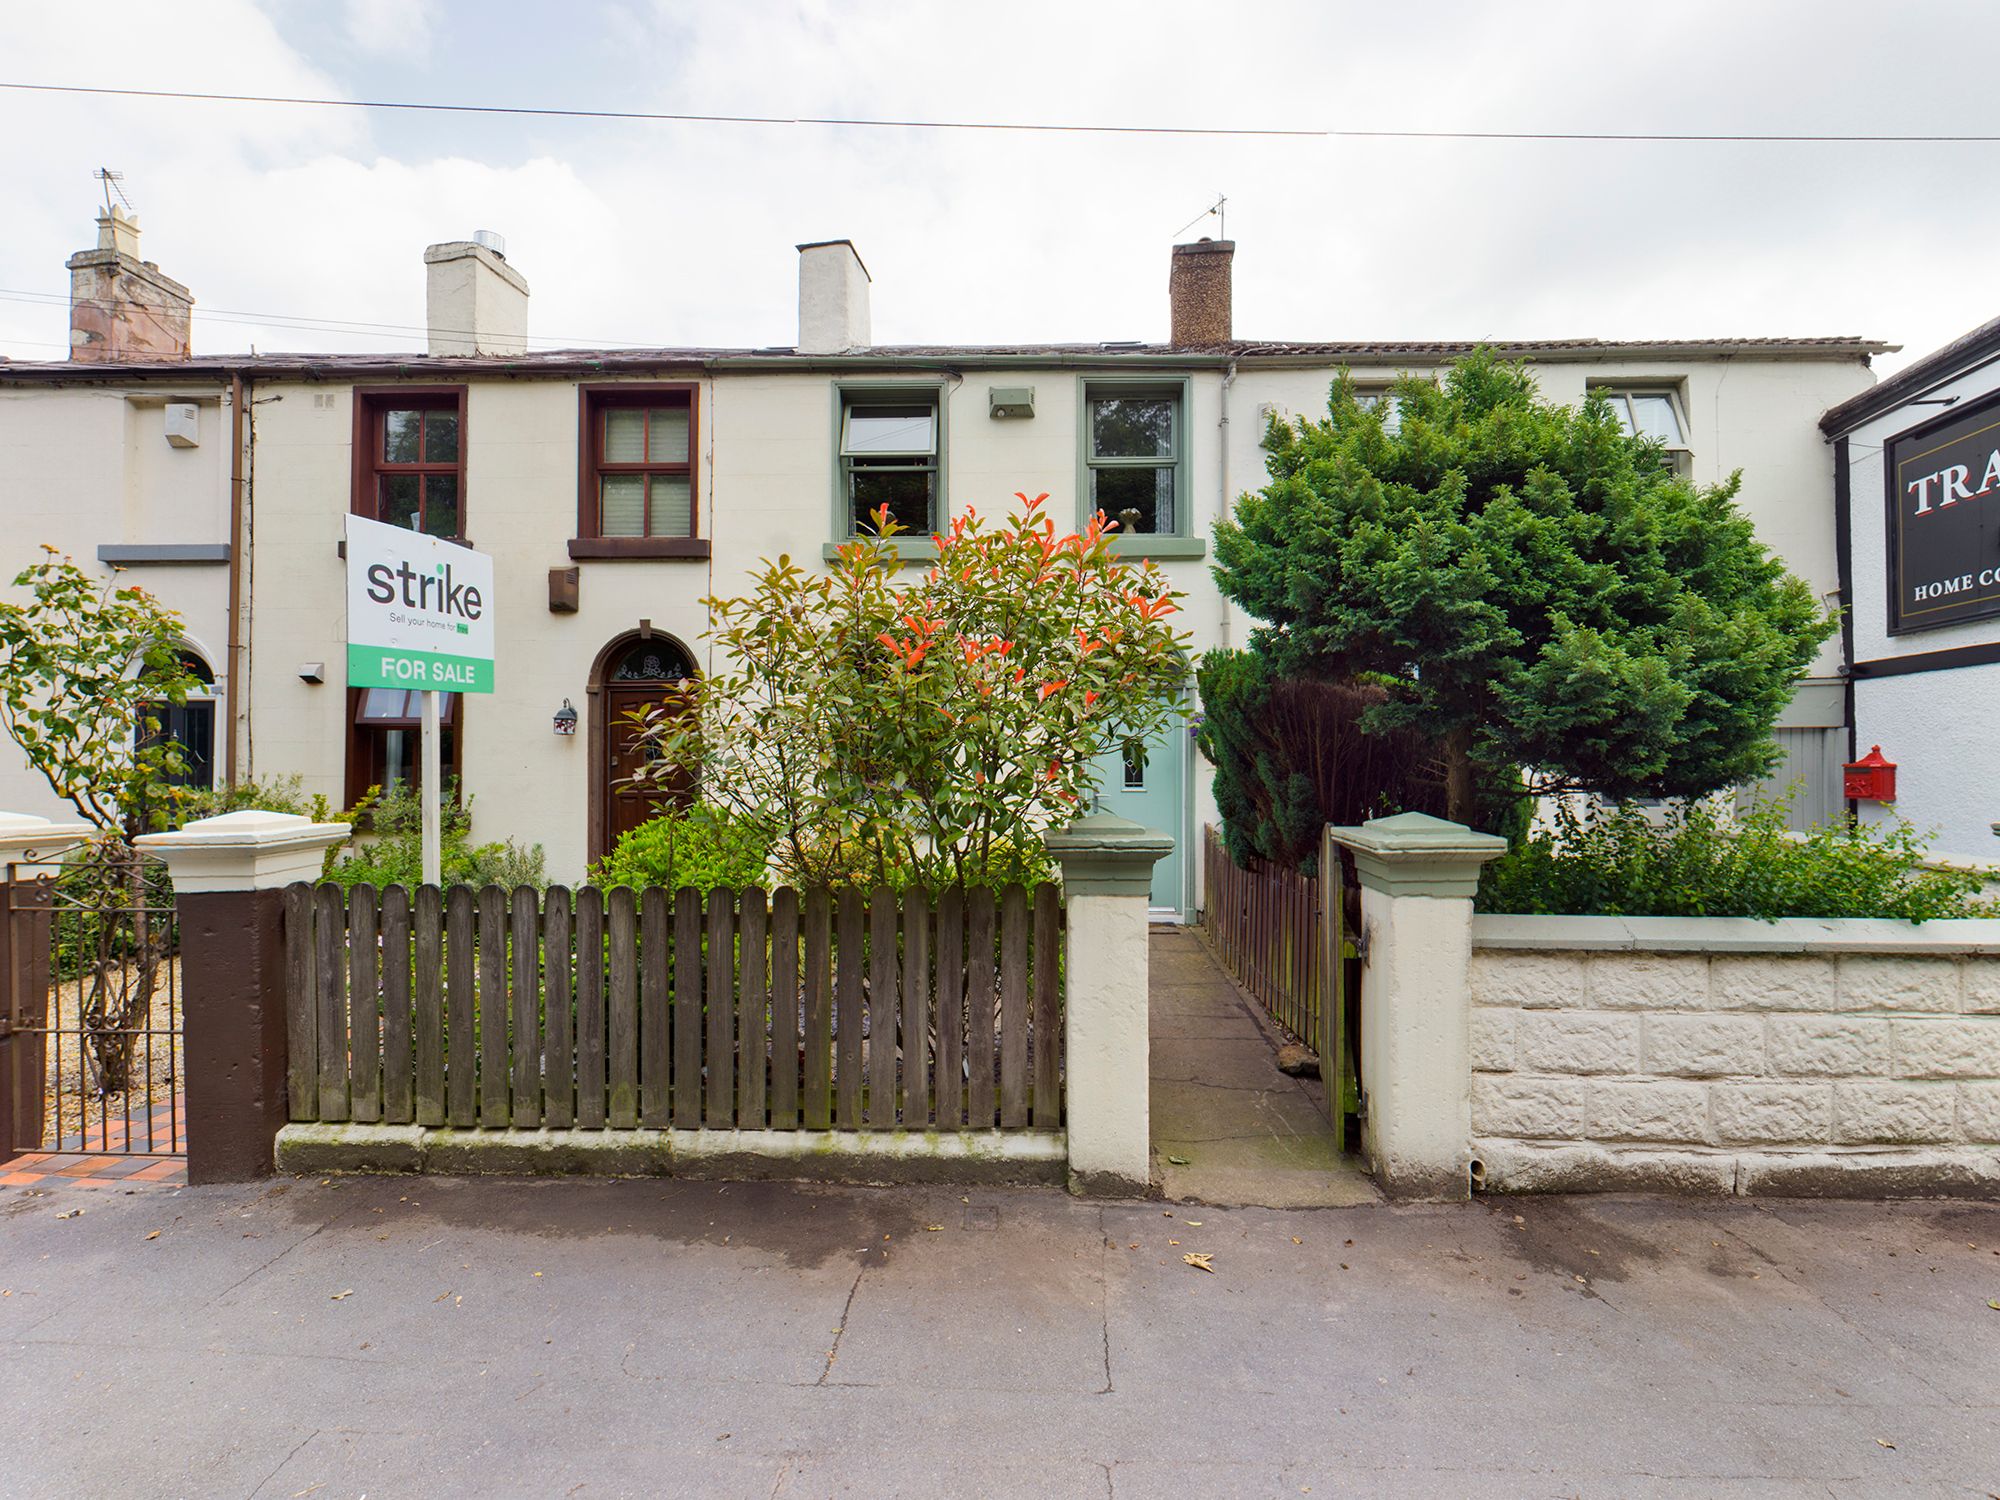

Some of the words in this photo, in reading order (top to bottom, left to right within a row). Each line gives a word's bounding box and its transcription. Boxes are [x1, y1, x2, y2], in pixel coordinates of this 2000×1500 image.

[367, 561, 482, 620] strike
[1914, 575, 1973, 601] HOME
[390, 613, 405, 624] Sell
[407, 618, 425, 627] your
[427, 619, 446, 630] home
[447, 622, 456, 631] for
[381, 657, 426, 680] FOR
[432, 662, 475, 684] SALE
